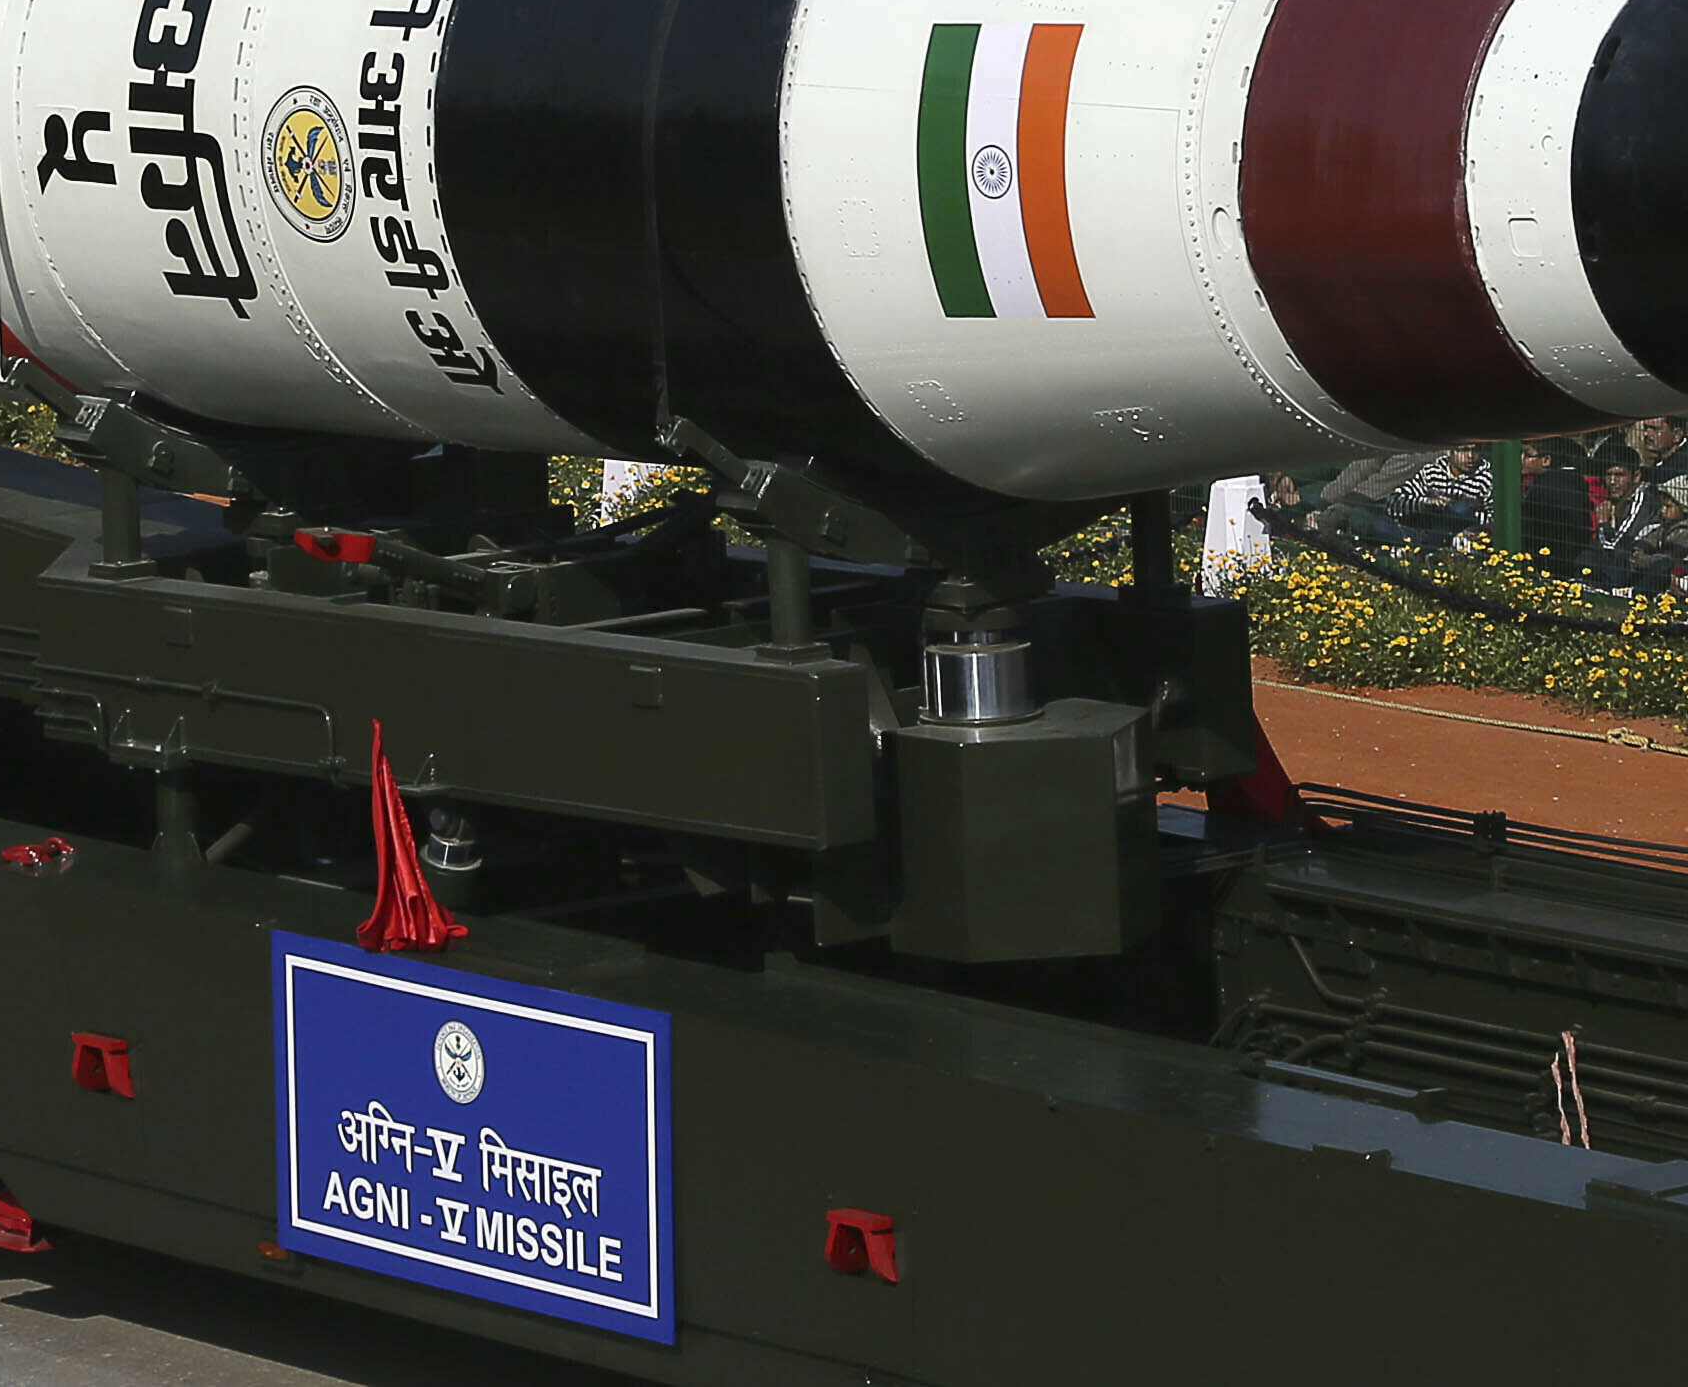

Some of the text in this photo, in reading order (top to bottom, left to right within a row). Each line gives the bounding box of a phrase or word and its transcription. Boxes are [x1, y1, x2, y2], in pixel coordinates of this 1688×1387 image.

[478, 1126, 602, 1219] मिसाइल
[323, 1170, 410, 1231] AGNI
[476, 1206, 623, 1282] MISSILE
